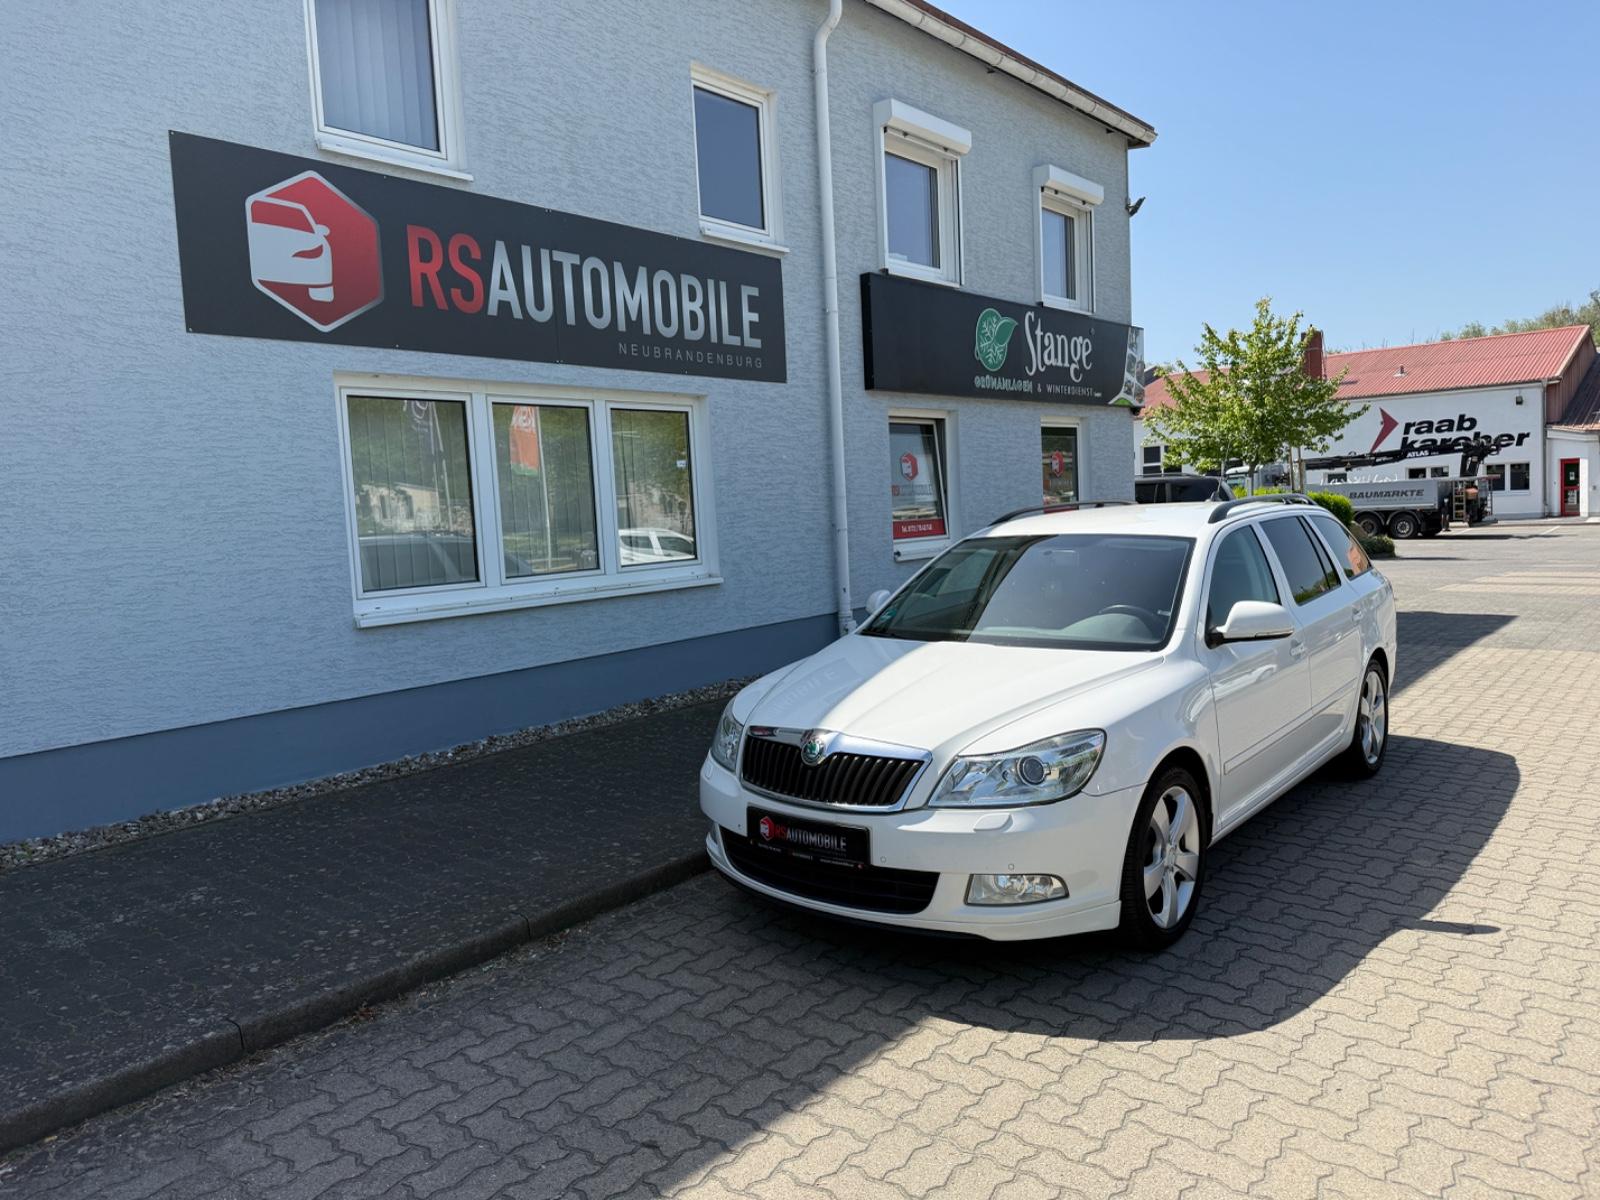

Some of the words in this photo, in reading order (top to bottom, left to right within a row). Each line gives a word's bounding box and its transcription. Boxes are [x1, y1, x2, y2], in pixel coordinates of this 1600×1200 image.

[406, 224, 762, 349] RSAUTOMOBILE
[618, 342, 763, 369] NEUBRANDENBURG
[1025, 311, 1092, 383] Stange
[1046, 383, 1094, 397] WINTERDIENST
[1403, 414, 1478, 436] raab
[1407, 450, 1430, 459] ATLAS
[774, 824, 847, 852] RSAUTOMOBILE
